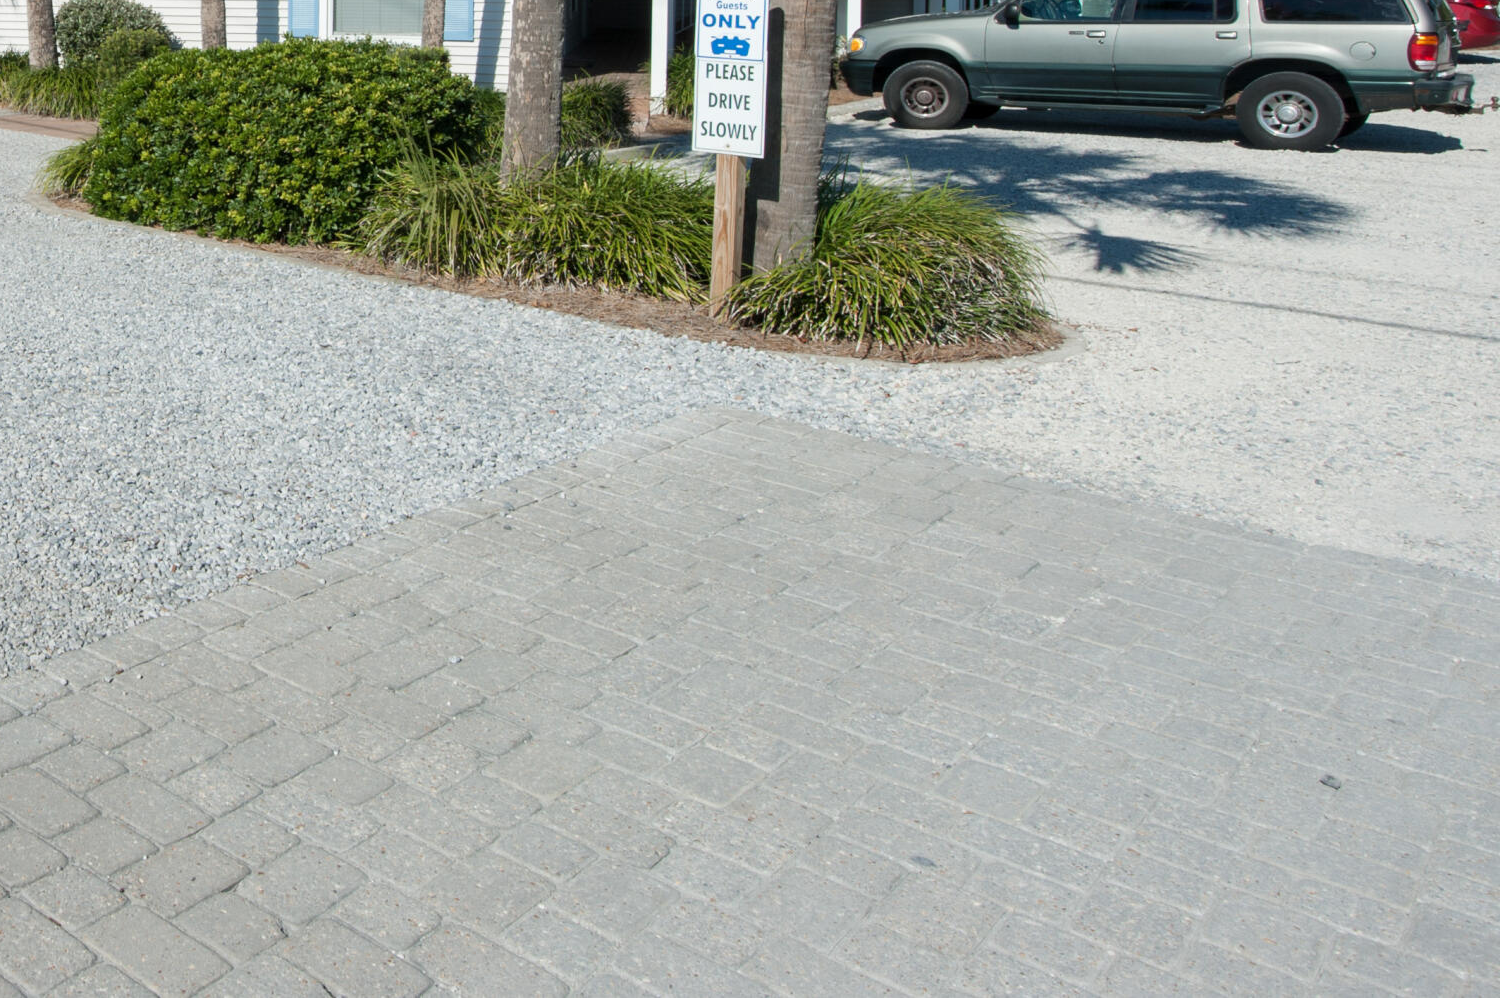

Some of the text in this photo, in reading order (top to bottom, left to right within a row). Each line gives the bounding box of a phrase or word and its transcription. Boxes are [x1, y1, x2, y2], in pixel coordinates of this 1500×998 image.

[716, 0, 749, 10] Guests
[702, 13, 761, 29] ONLY
[706, 63, 755, 81] PLEASE
[708, 92, 750, 111] DRIVE
[700, 120, 757, 141] SLOWLY
